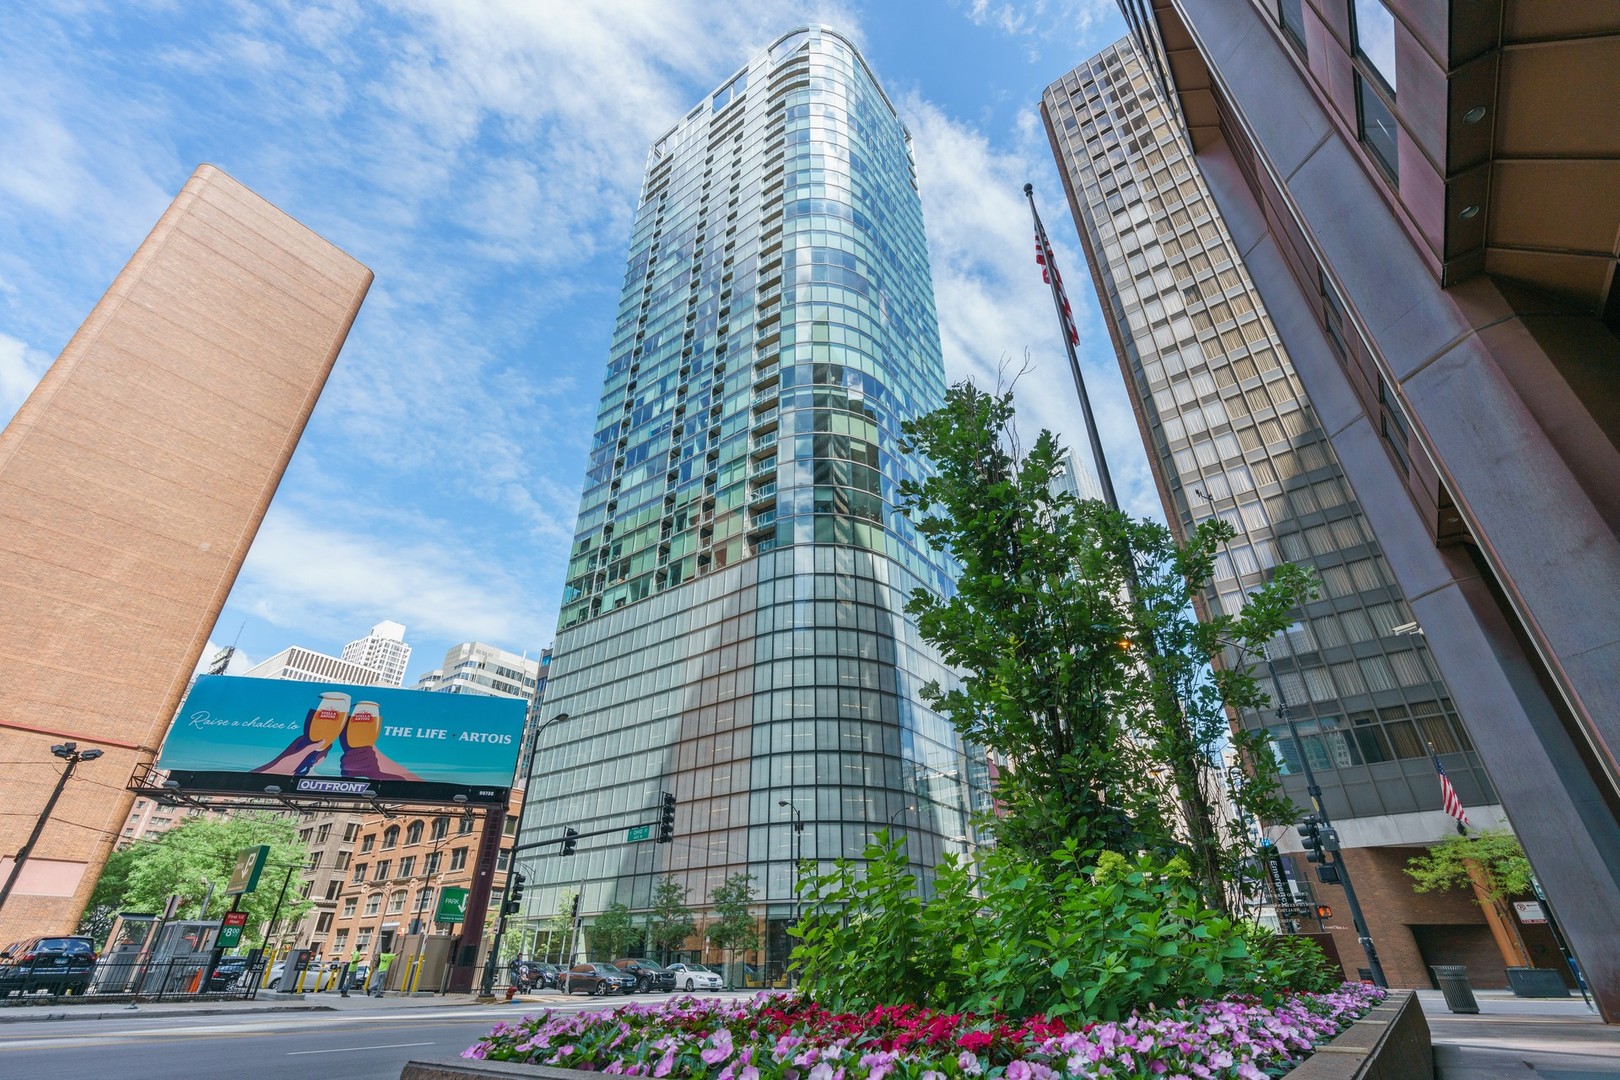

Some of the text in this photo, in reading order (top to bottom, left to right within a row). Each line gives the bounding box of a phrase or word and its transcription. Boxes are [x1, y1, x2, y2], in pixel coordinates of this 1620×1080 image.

[189, 710, 300, 730] Raise a chalice to
[384, 725, 512, 745] THE LIFE ARTOIS
[300, 780, 366, 792] OUTFRONT
[1269, 860, 1288, 907] Emergency
[444, 897, 460, 905] PARK
